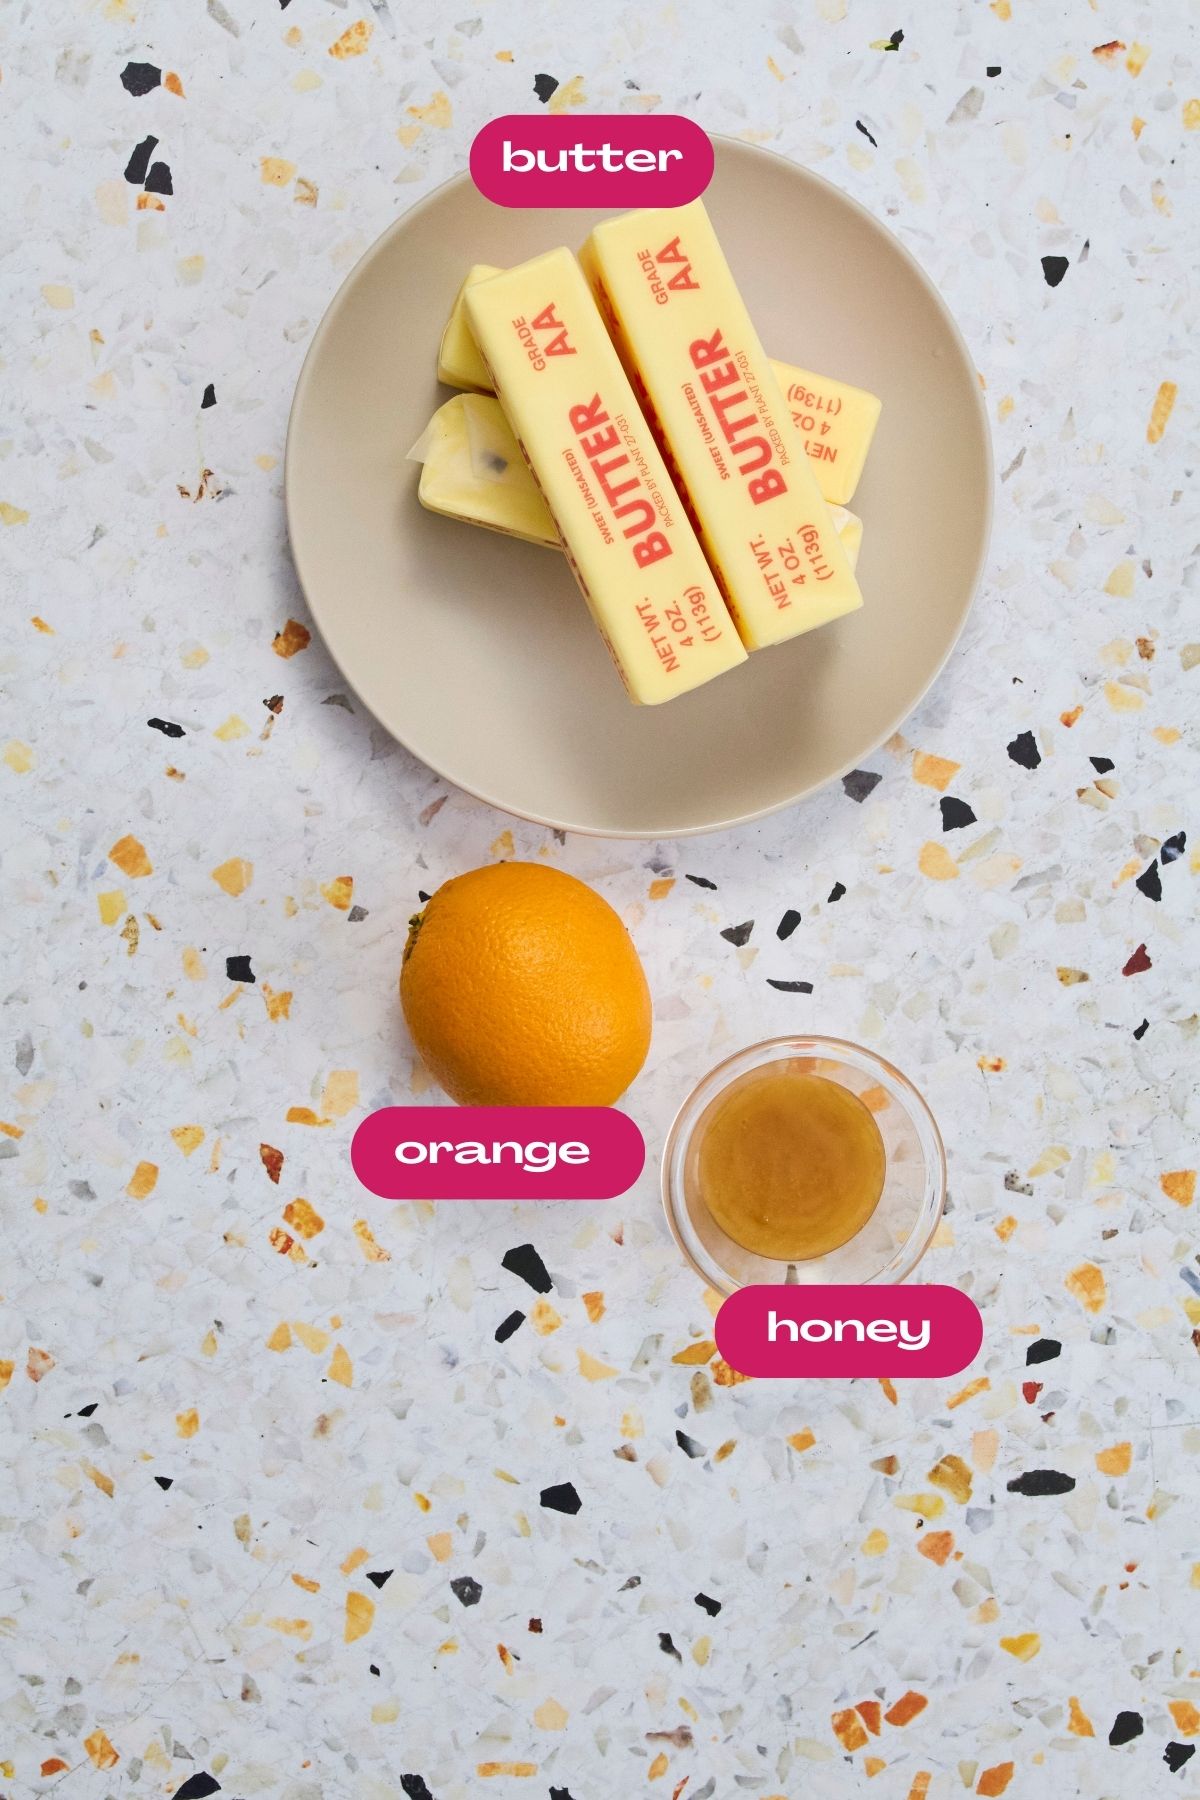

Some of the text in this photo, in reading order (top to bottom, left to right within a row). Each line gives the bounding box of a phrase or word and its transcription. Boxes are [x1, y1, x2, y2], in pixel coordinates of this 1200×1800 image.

[637, 249, 669, 305] GRADE
[655, 236, 700, 291] AA
[512, 316, 546, 371] GRADE
[531, 302, 577, 357] AA
[688, 328, 788, 505] BUTTER
[735, 350, 790, 467] PACKED BY PLANT 27-031
[787, 383, 842, 416] (113g)
[681, 382, 730, 481] SWEET (UNSALTED)
[820, 421, 831, 436] 4
[563, 448, 614, 545] SWEET (UNSALTED)
[568, 392, 673, 569] BUTTER
[614, 413, 673, 528] PACKED BY PLANT 27-031
[750, 533, 792, 610] NET WT.
[776, 537, 806, 585] 4 OZ.
[797, 523, 833, 581] (113g)
[635, 597, 681, 673] NET WT.
[664, 599, 694, 647] 4 OZ.
[683, 585, 722, 642] (113g)
